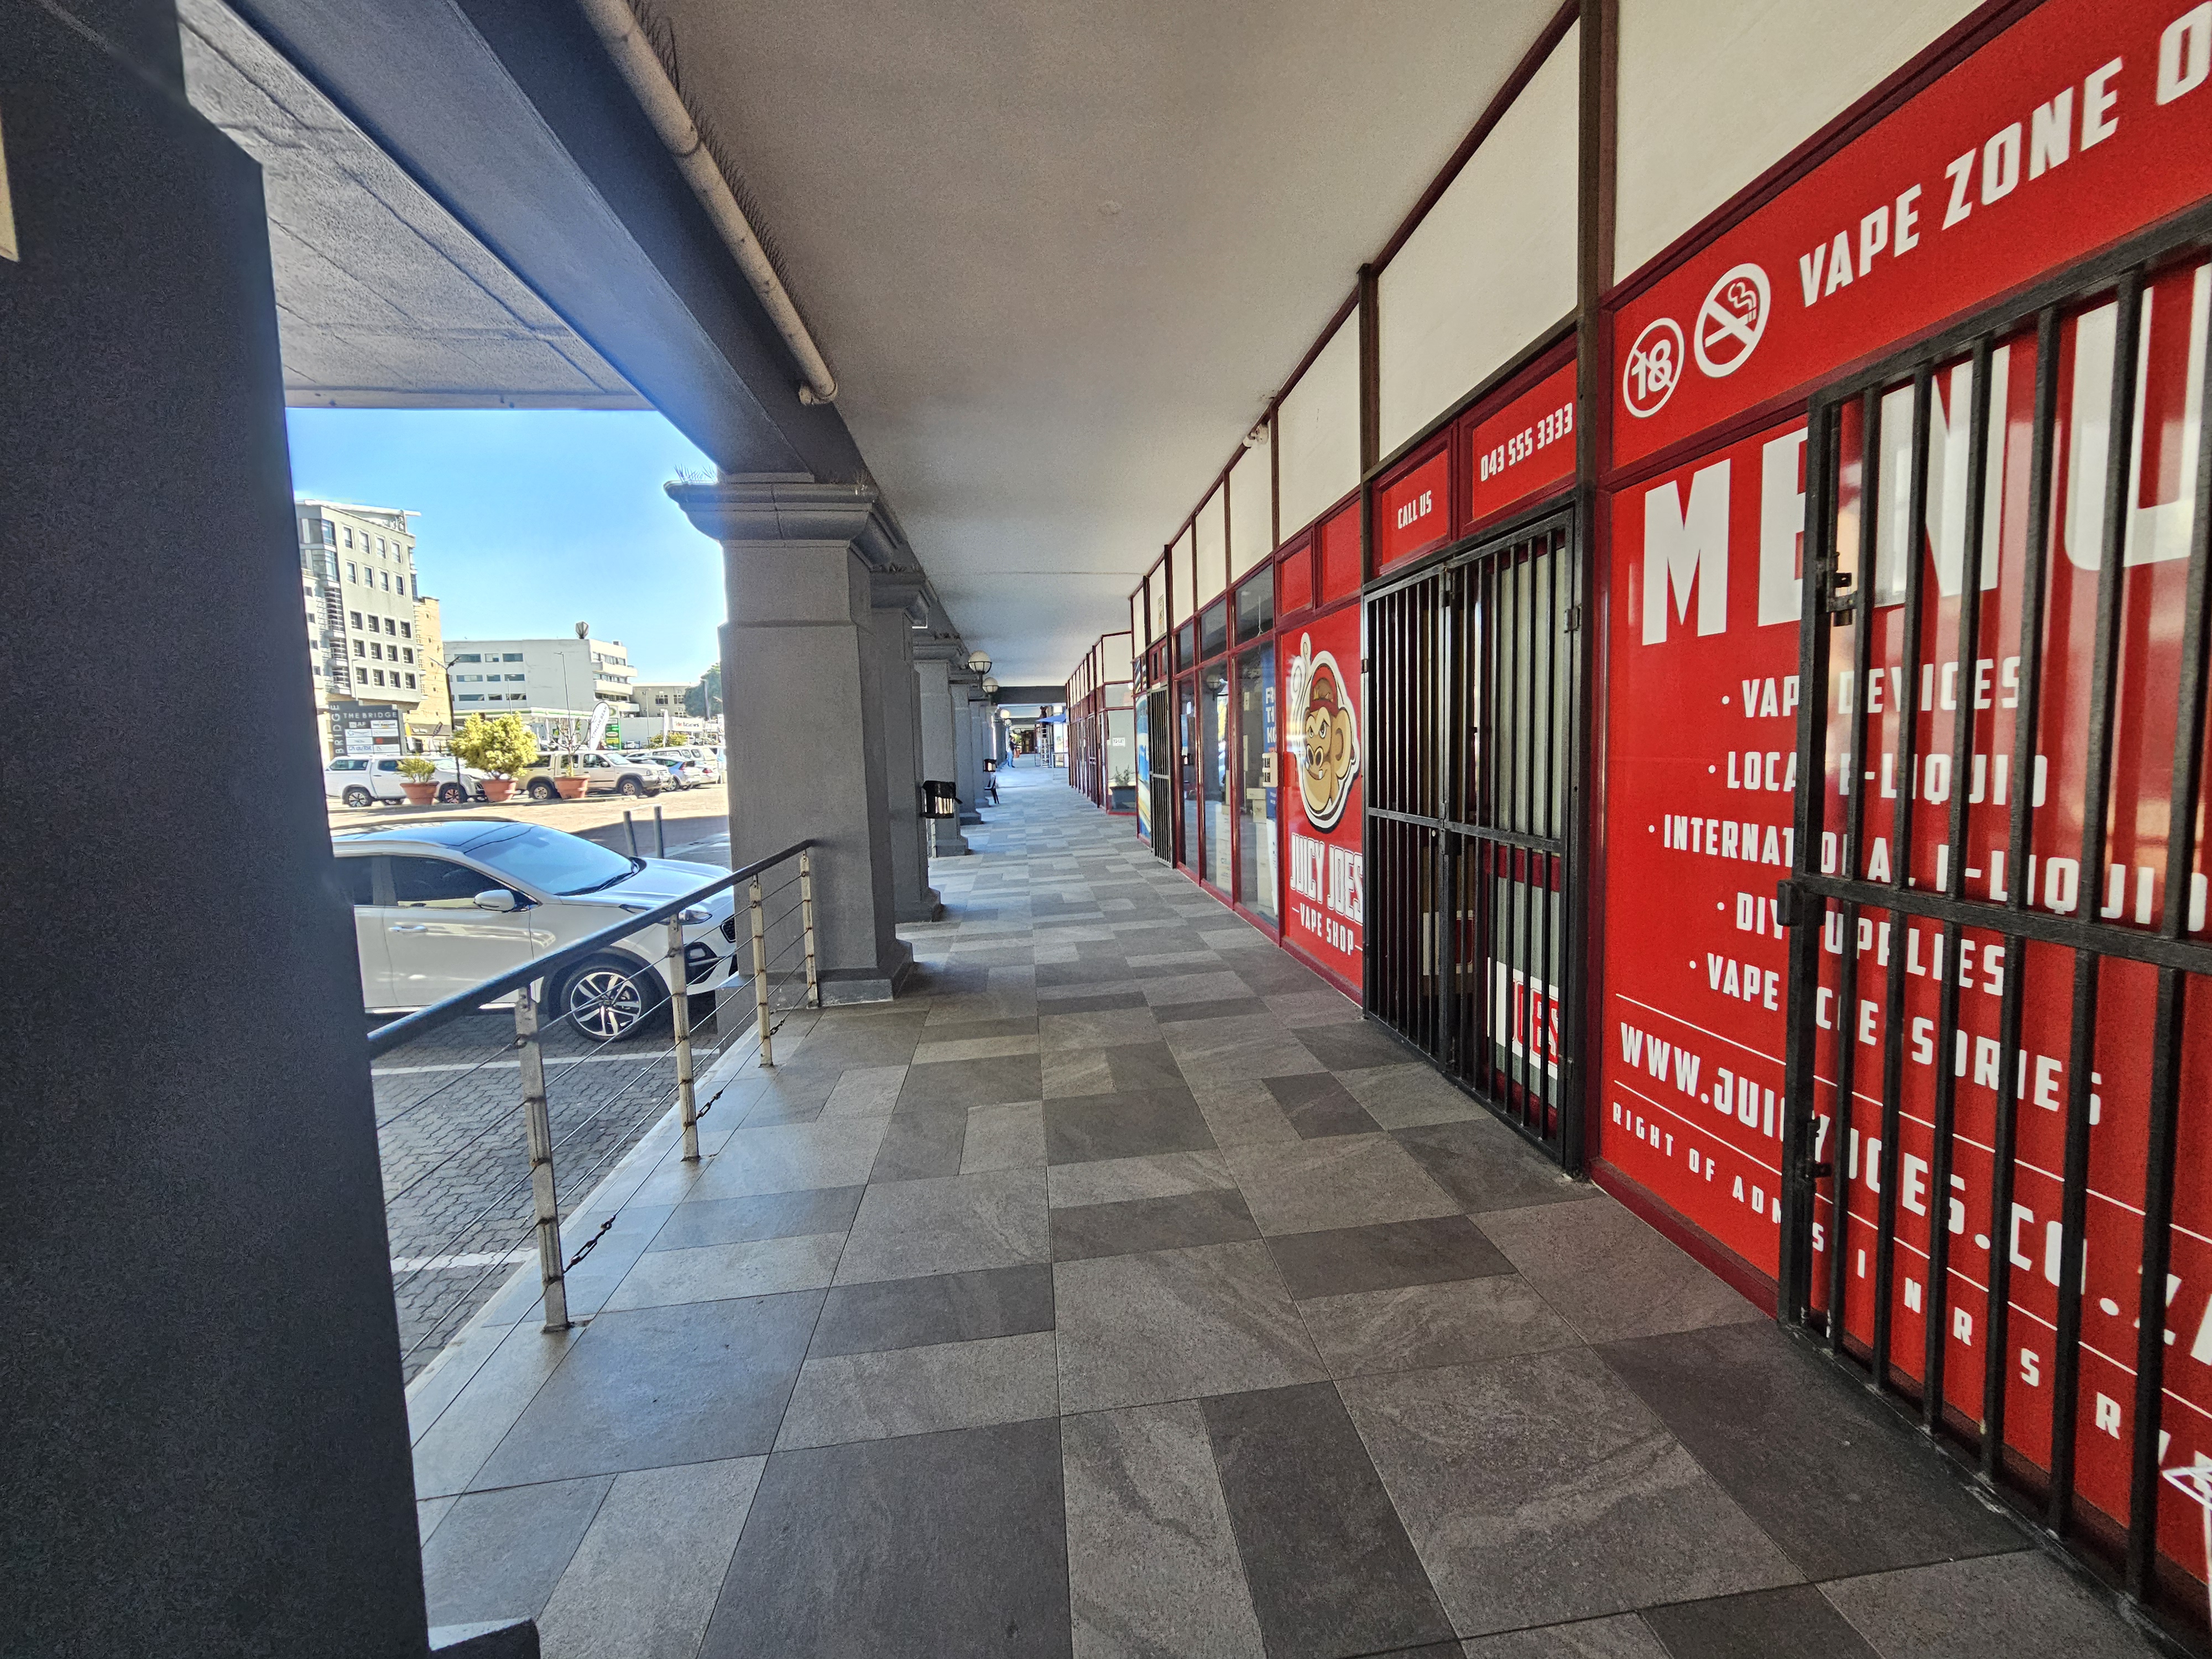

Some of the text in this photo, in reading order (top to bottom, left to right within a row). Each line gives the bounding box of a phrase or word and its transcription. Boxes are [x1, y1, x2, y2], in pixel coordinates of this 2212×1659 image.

[1799, 183, 1922, 308] VAPE
[1941, 55, 2123, 231] ZONE
[1631, 339, 1672, 401] 18
[1480, 402, 1573, 482] 043 555 3333
[1397, 490, 1432, 530] CALL US
[1741, 675, 1801, 718] VAP
[1726, 751, 1797, 792] LOCA
[1290, 832, 1363, 927] JUICY JOES
[1300, 902, 1354, 956] VAPE SHOP
[1736, 891, 2006, 996] DIY UPPLIES
[1707, 952, 1780, 1011] VAPE
[1613, 1101, 1674, 1157] RIGHT
[1689, 1147, 1715, 1182] OF
